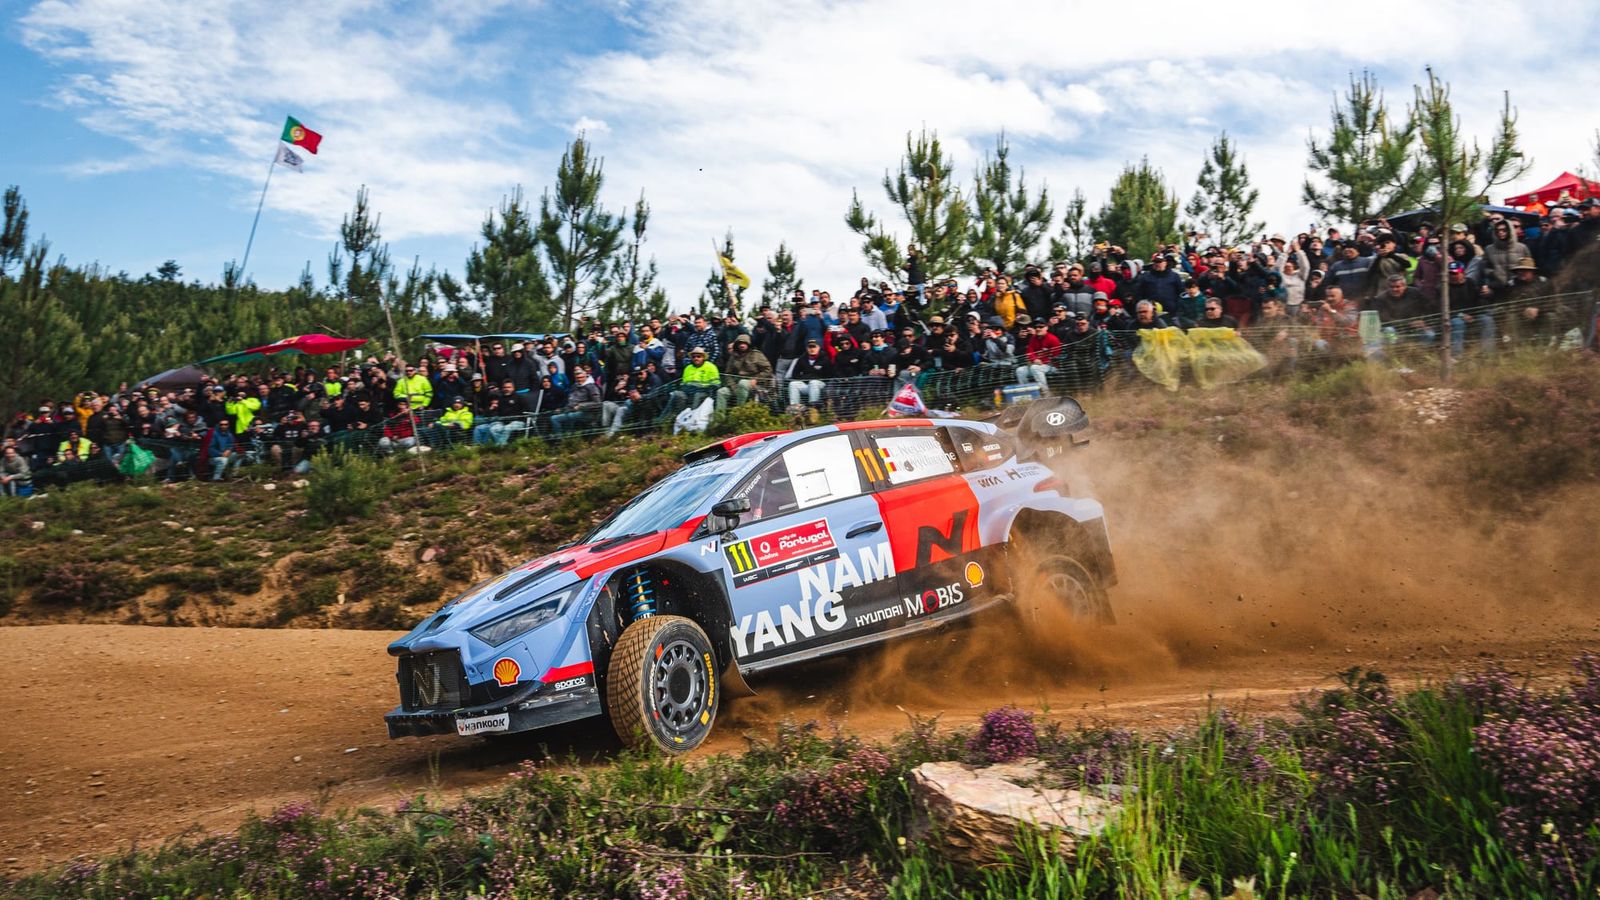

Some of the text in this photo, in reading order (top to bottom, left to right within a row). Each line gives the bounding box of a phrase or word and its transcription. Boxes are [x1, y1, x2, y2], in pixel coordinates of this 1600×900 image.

[854, 447, 885, 482] 11
[729, 541, 754, 572] 11
[758, 551, 779, 561] vodafone
[779, 530, 829, 550] Portugal
[798, 542, 896, 600] NAM
[854, 582, 963, 627] HYUNDAI MOBIS
[730, 591, 848, 658] YANG
[554, 676, 586, 691] sparco
